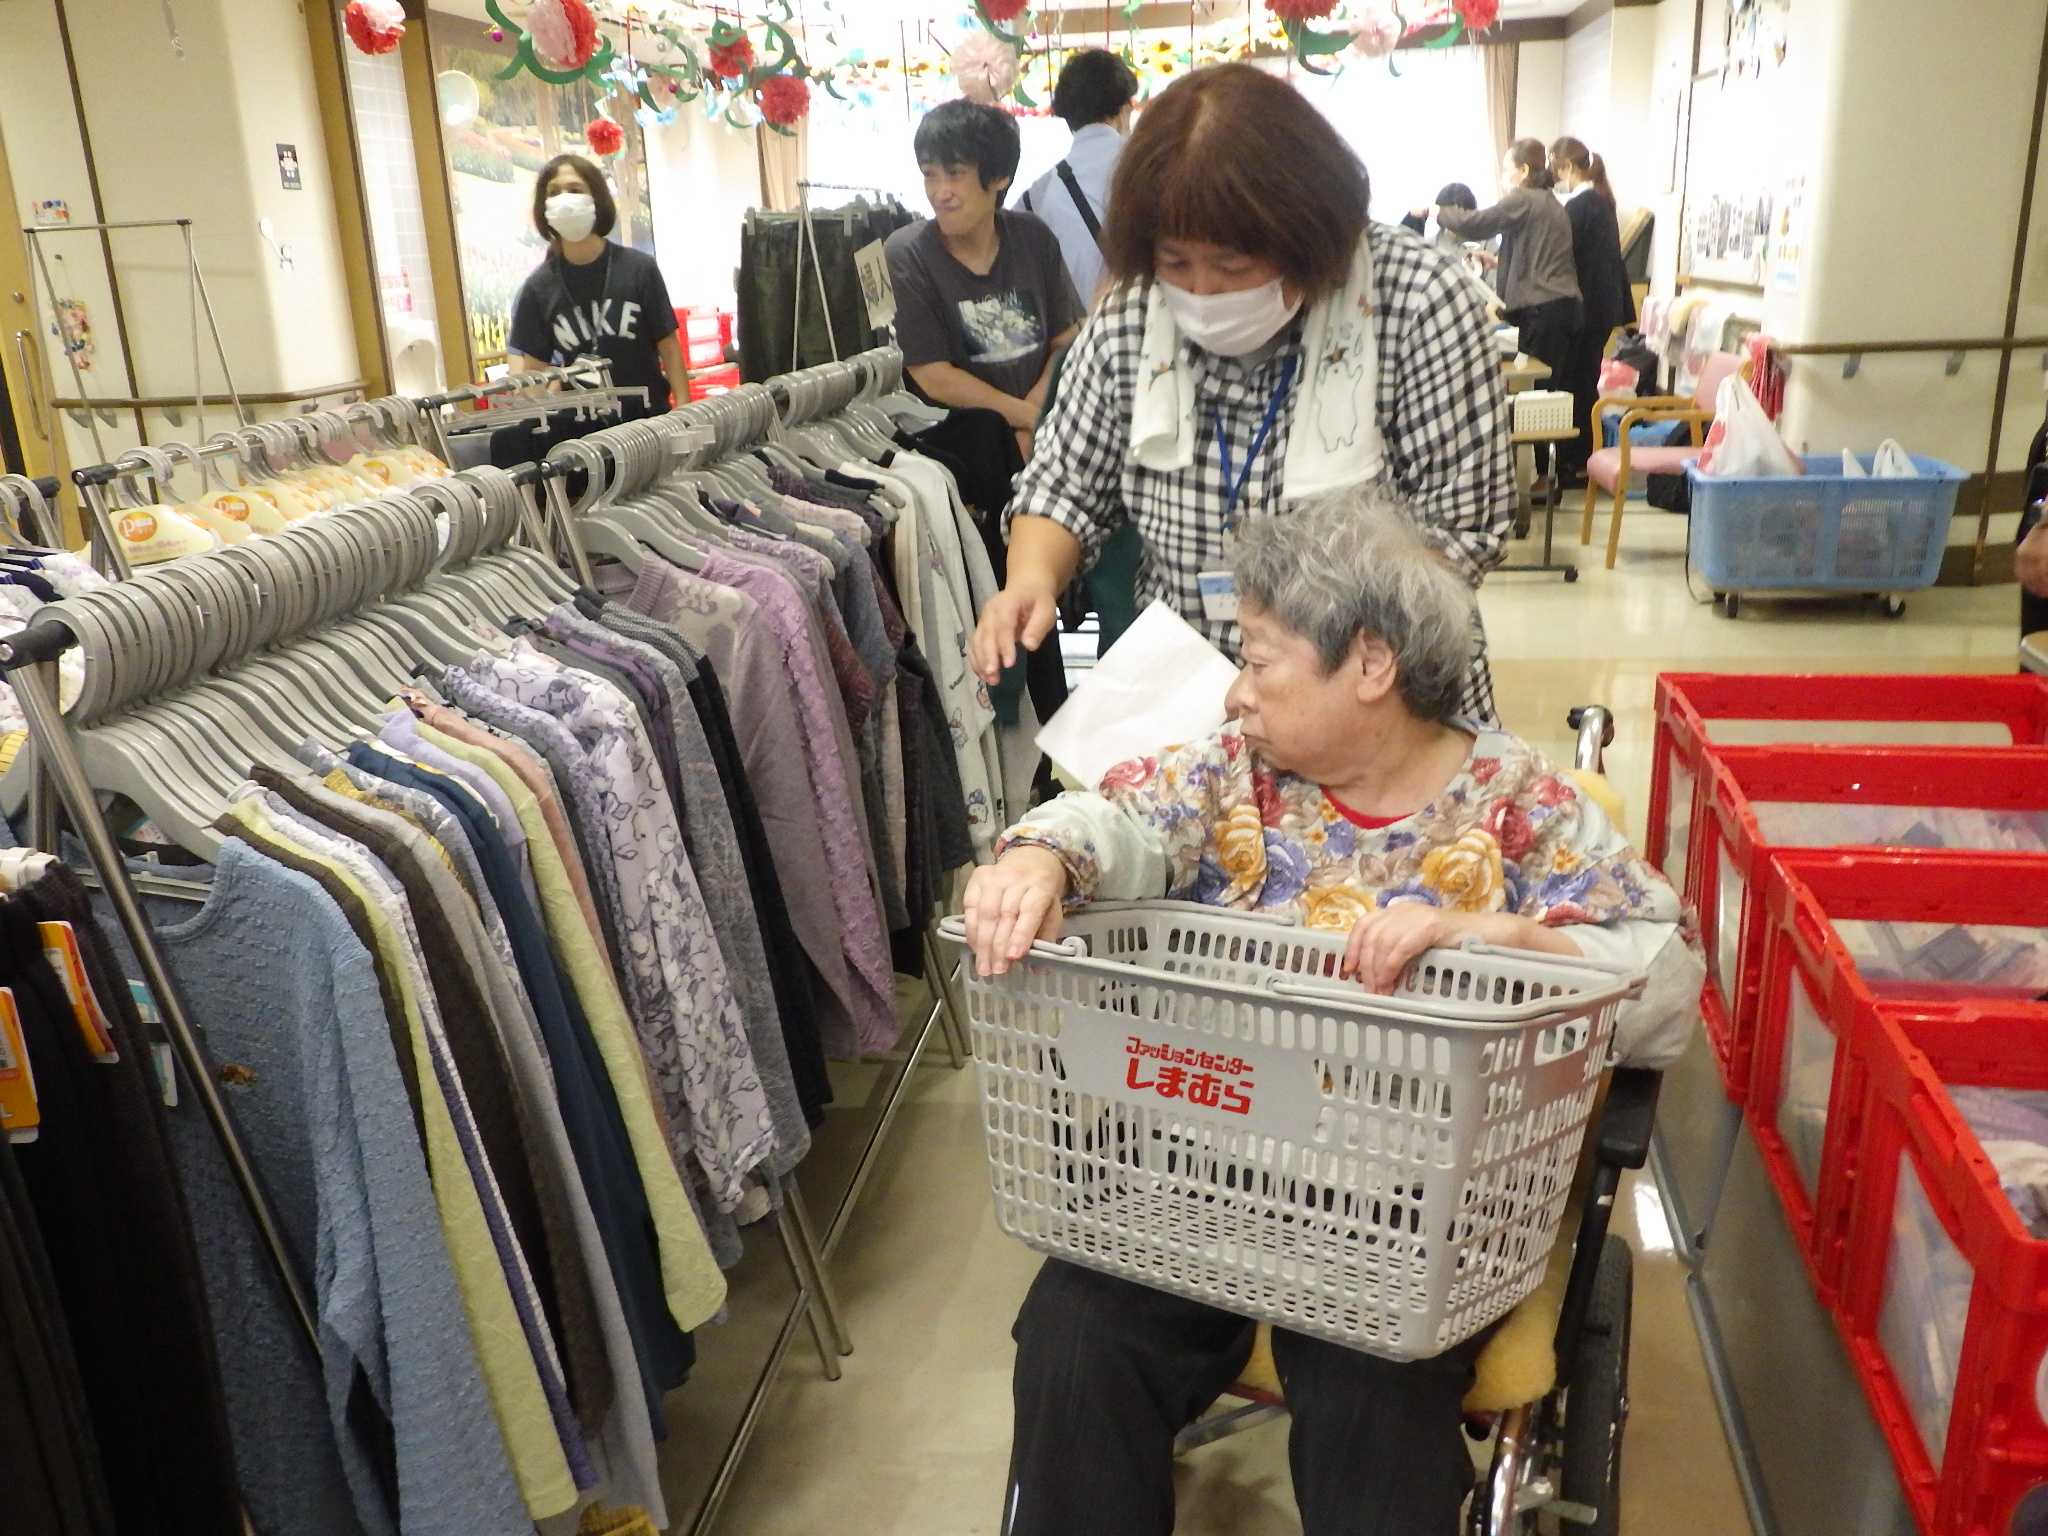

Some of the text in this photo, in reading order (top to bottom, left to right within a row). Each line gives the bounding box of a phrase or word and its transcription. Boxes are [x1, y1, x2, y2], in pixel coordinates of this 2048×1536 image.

[553, 299, 642, 351] NIKE
[1126, 1036, 1254, 1075] ファッションセンター
[1126, 1057, 1255, 1115] しまむら
